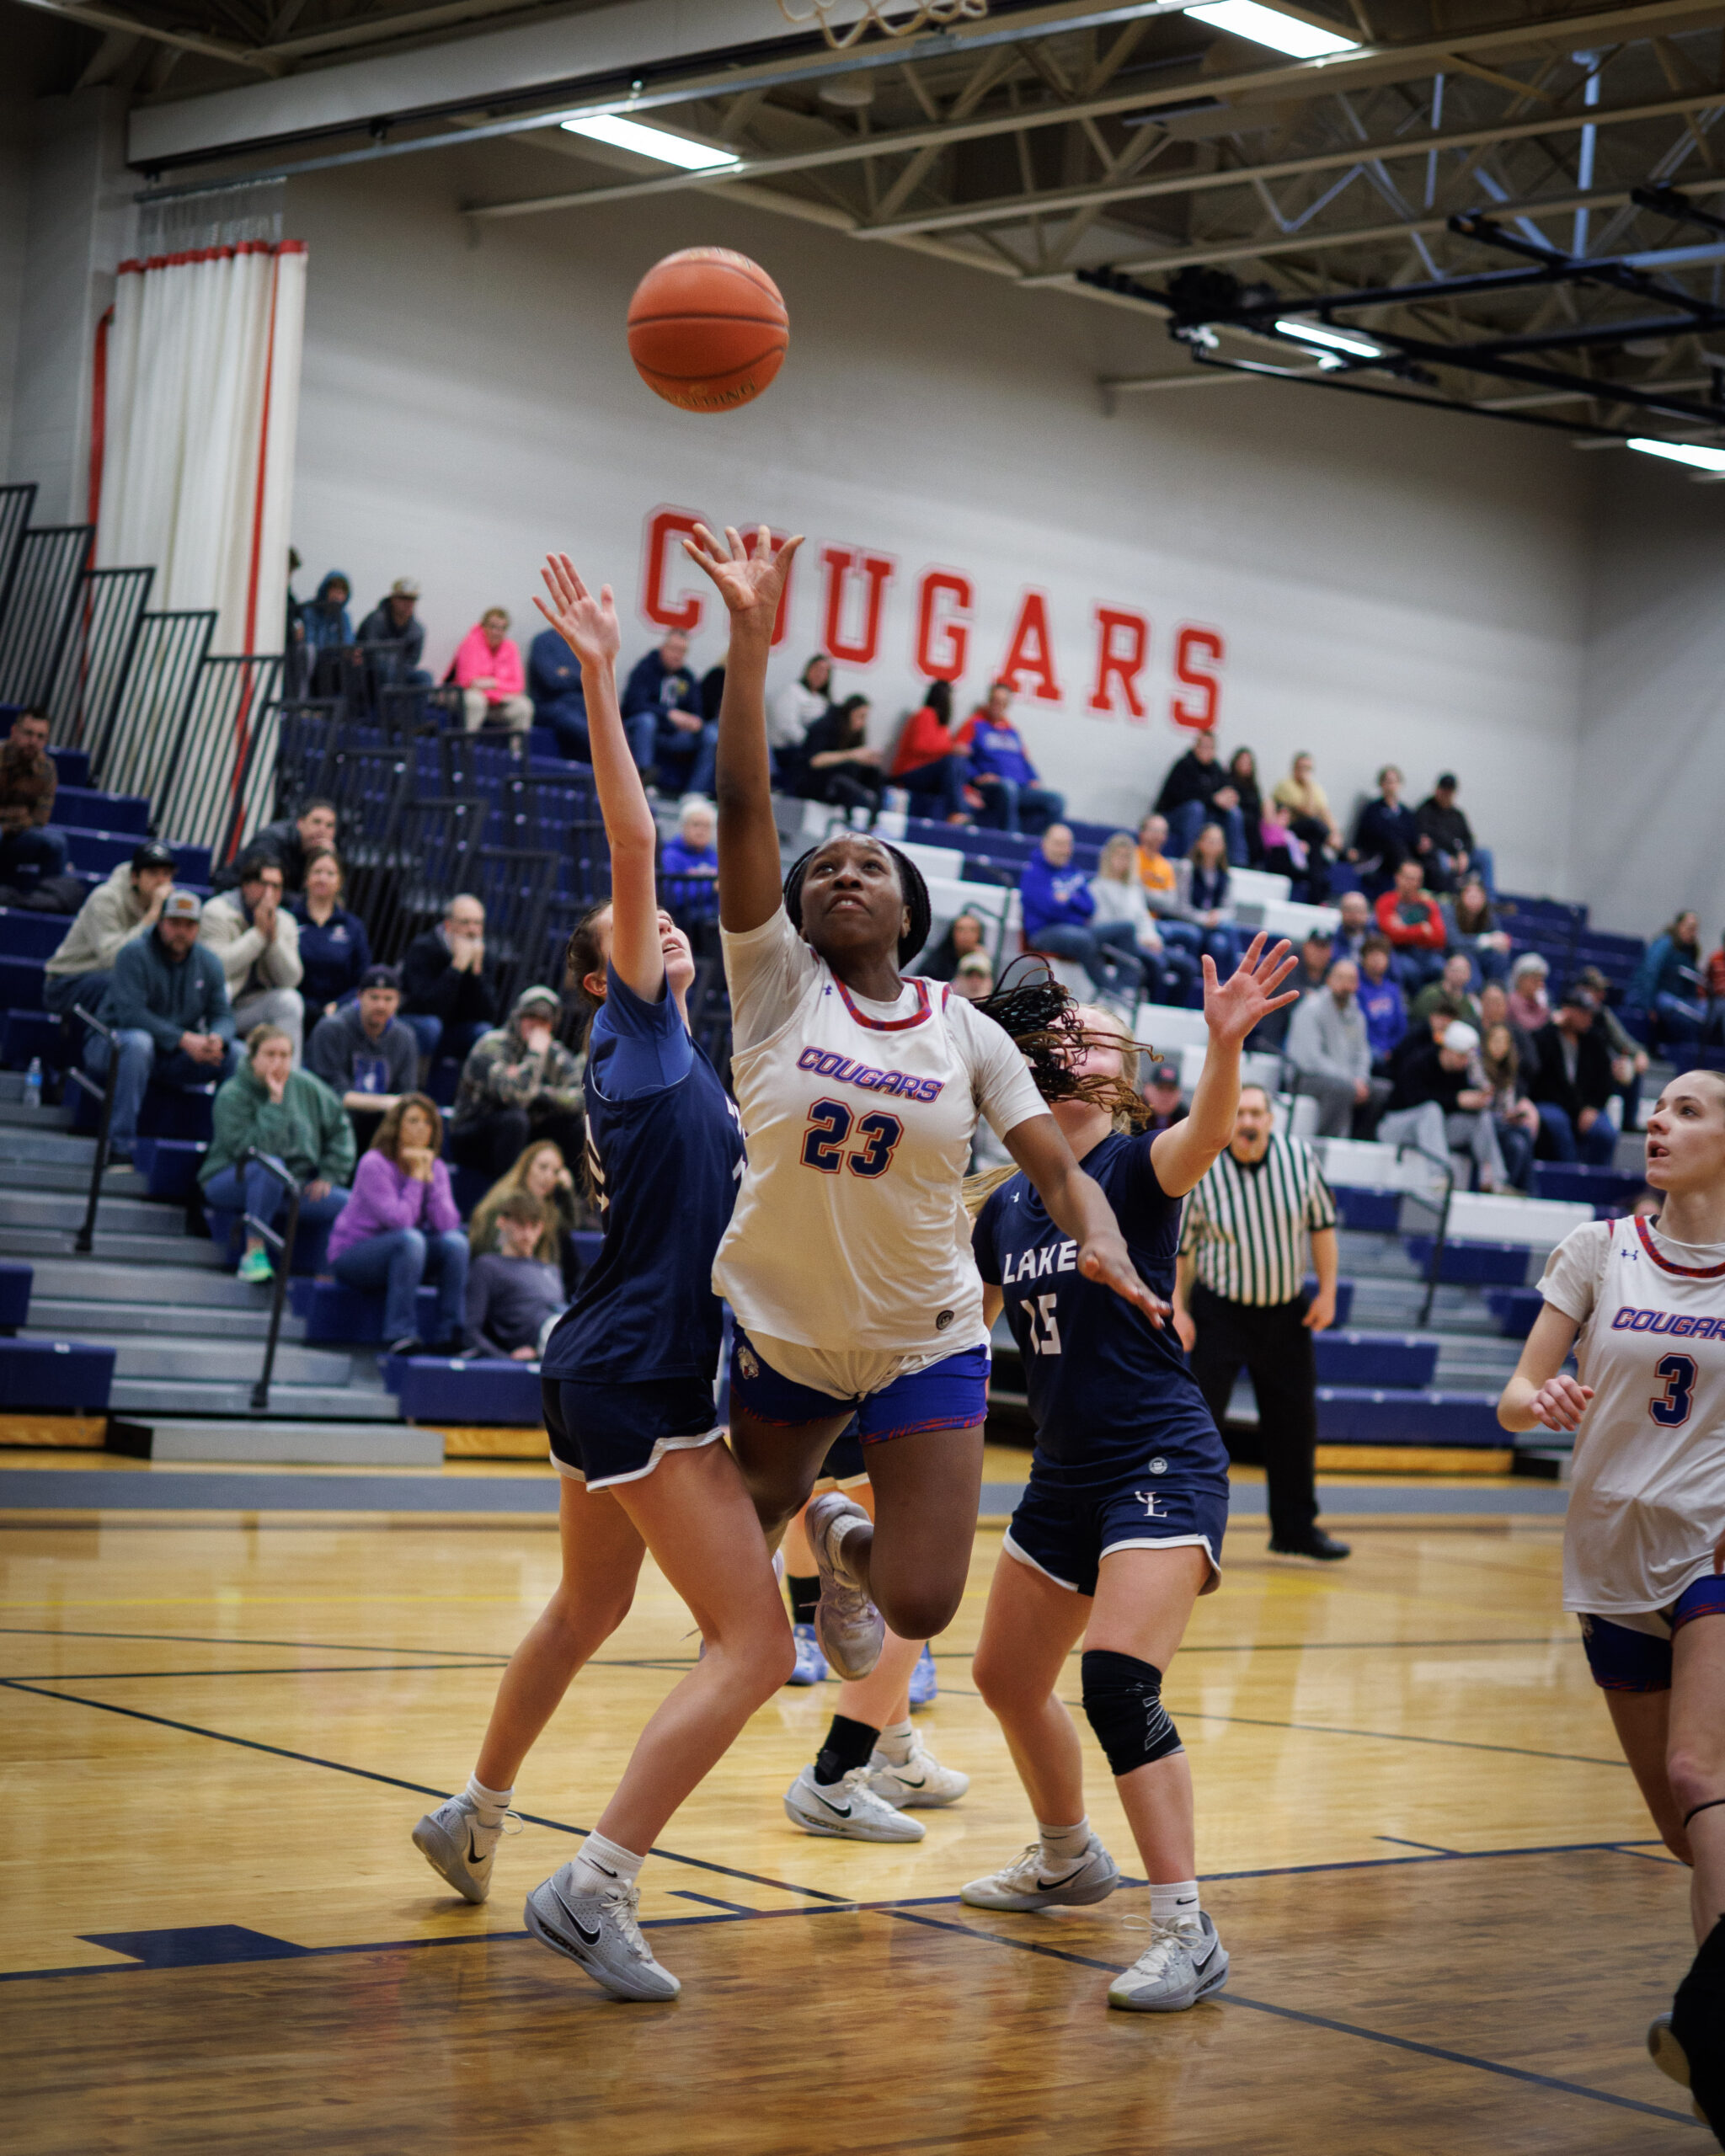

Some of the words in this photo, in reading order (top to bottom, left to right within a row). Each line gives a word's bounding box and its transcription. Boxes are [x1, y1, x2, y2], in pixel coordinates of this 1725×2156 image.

[796, 1045, 945, 1103] COUGARS
[799, 1097, 905, 1179] 23
[1020, 1293, 1061, 1354] 15
[1648, 1353, 1698, 1428] 3
